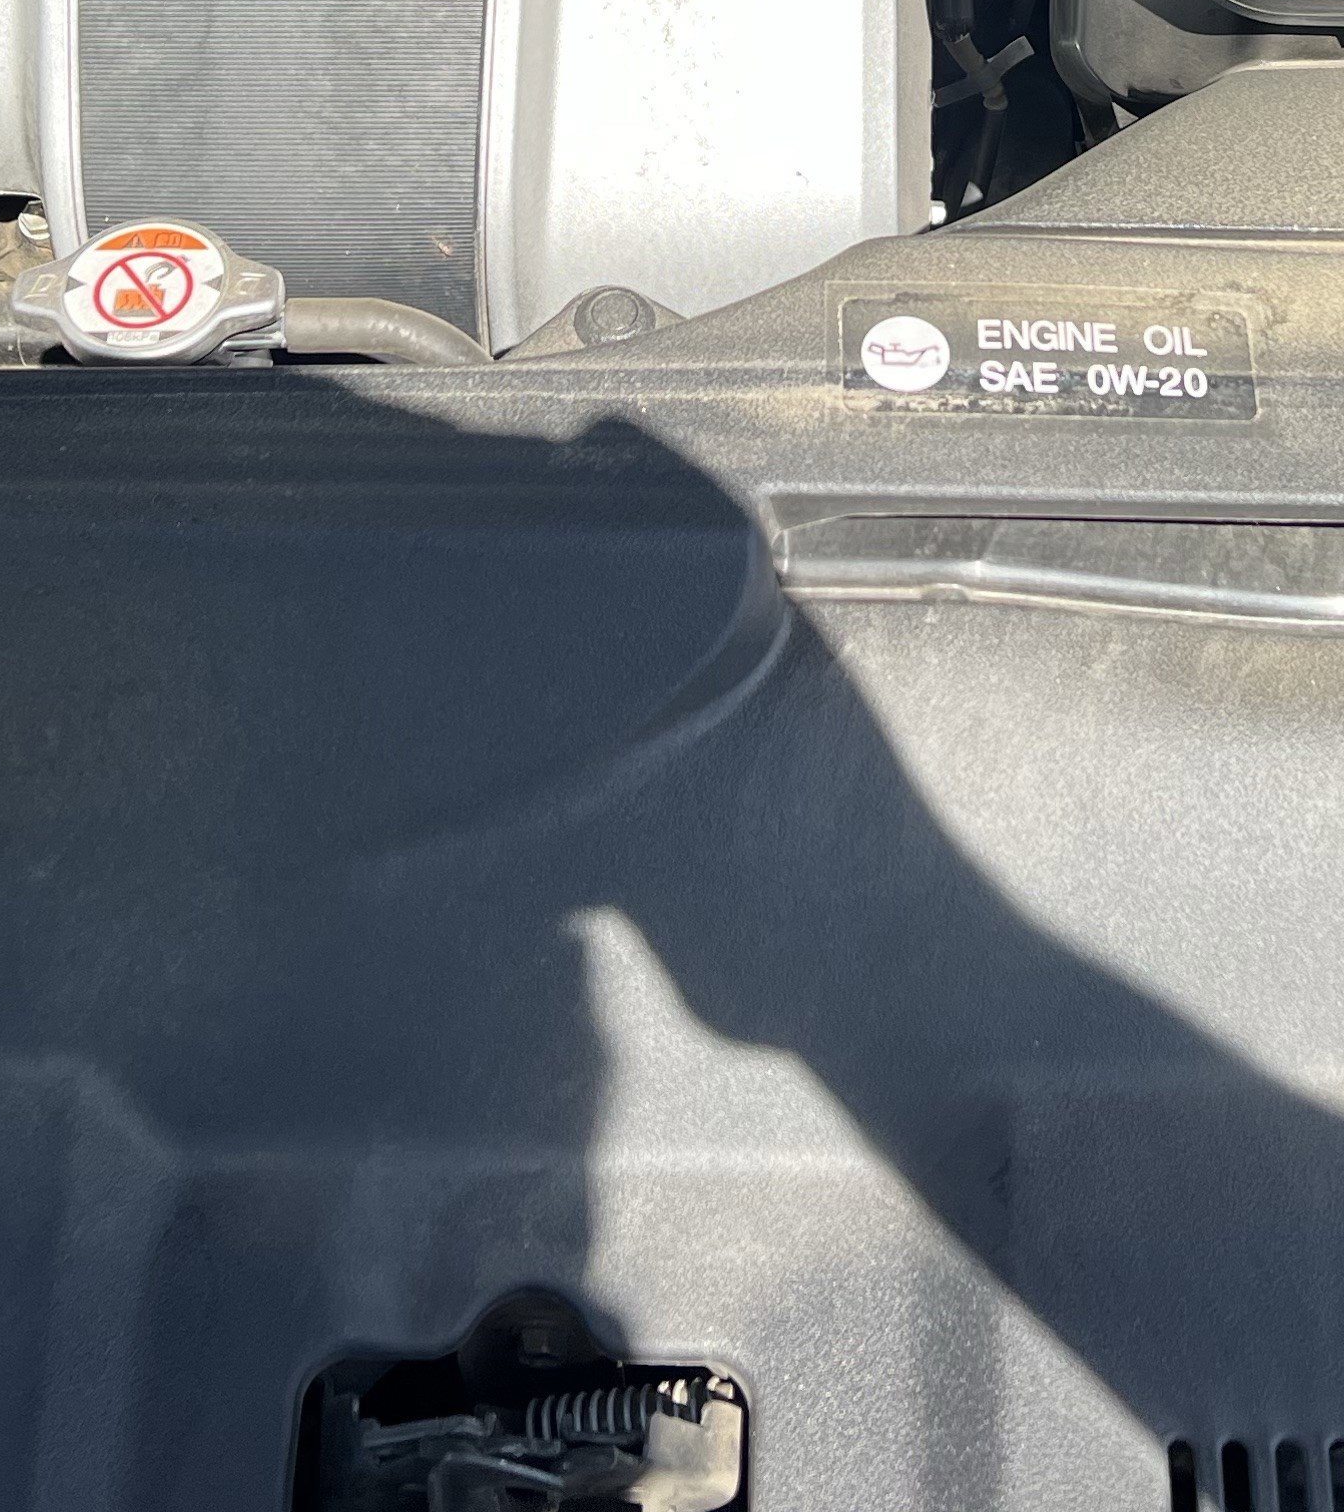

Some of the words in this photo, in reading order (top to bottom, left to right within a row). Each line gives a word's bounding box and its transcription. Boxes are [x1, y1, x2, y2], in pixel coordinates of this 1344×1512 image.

[977, 319, 1118, 353] ENGINE
[1143, 325, 1208, 357] OIL
[979, 360, 1059, 394] SAE
[1087, 364, 1208, 398] 0W-20
